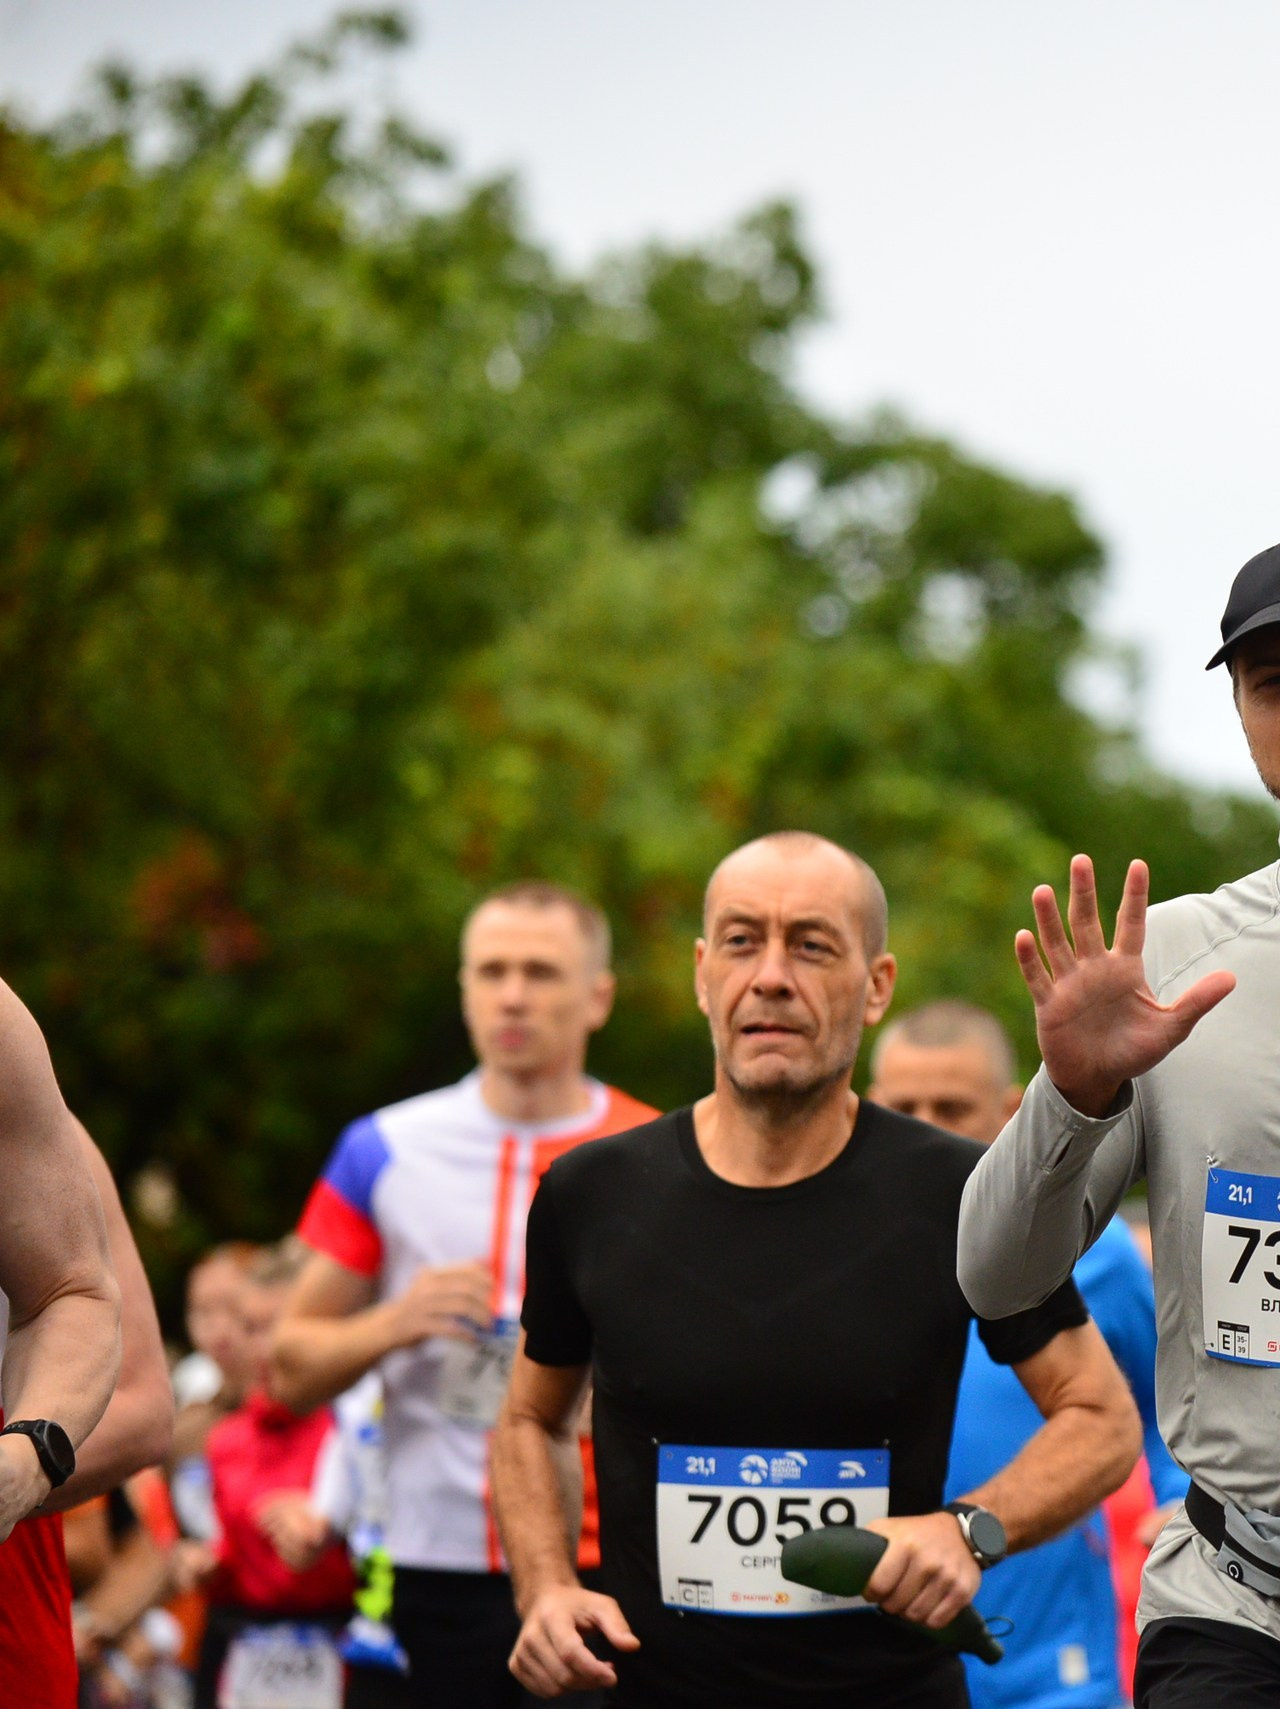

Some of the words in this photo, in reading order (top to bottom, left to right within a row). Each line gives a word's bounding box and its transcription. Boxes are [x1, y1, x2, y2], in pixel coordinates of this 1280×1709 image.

[1228, 1183, 1253, 1206] 21,1
[686, 1456, 716, 1477] 21,1
[688, 1494, 856, 1547] 7059
[741, 1556, 781, 1569] СЕРГ
